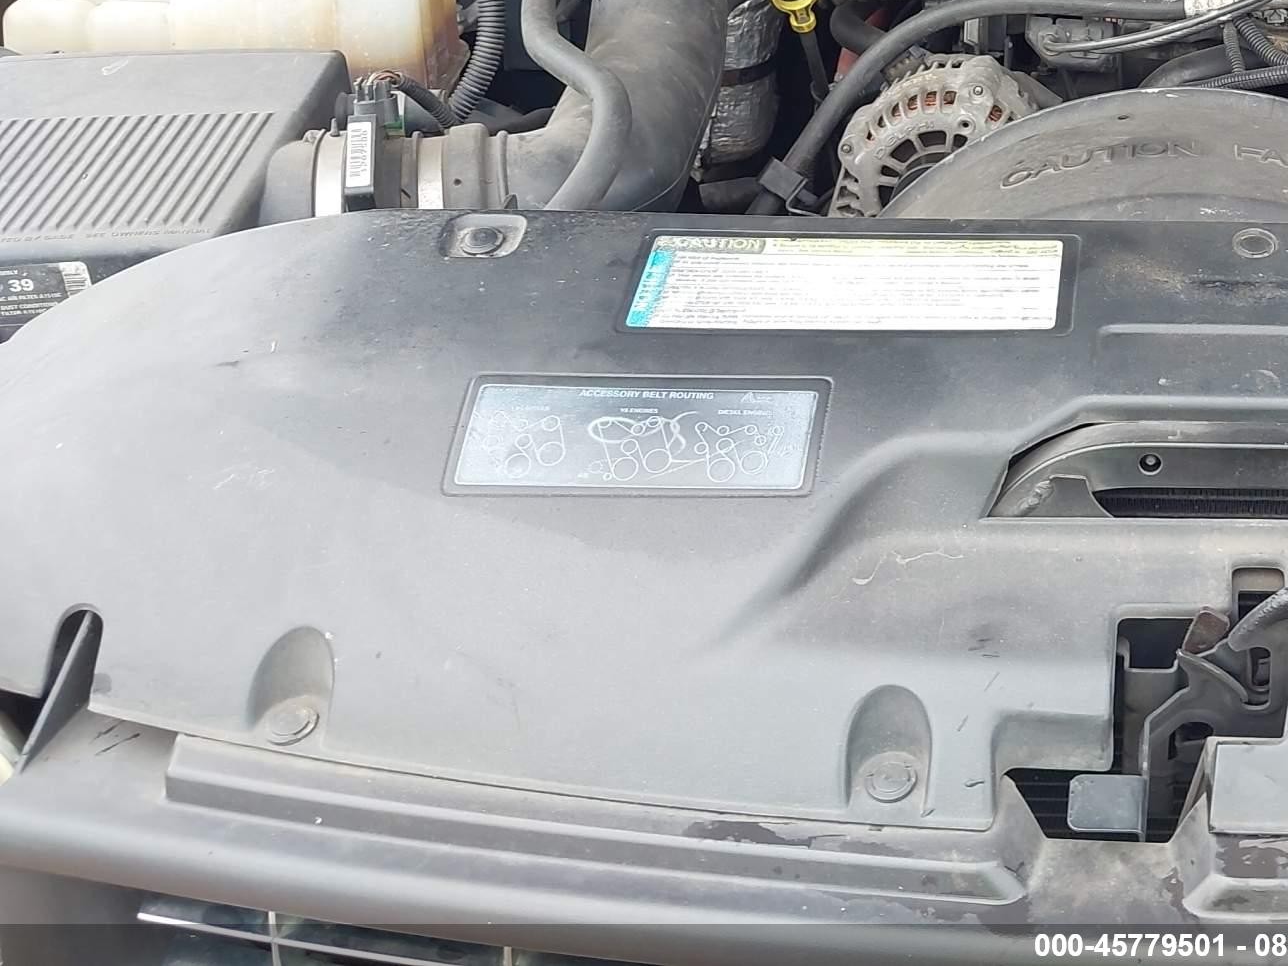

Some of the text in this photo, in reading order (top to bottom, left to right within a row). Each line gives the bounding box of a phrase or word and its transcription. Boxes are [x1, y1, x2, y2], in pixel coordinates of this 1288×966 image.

[1000, 141, 1200, 189] CAUTION
[677, 237, 761, 250] CAUTION
[7, 278, 34, 293] 39
[579, 389, 714, 400] ACCESSORY BELT ROUTING
